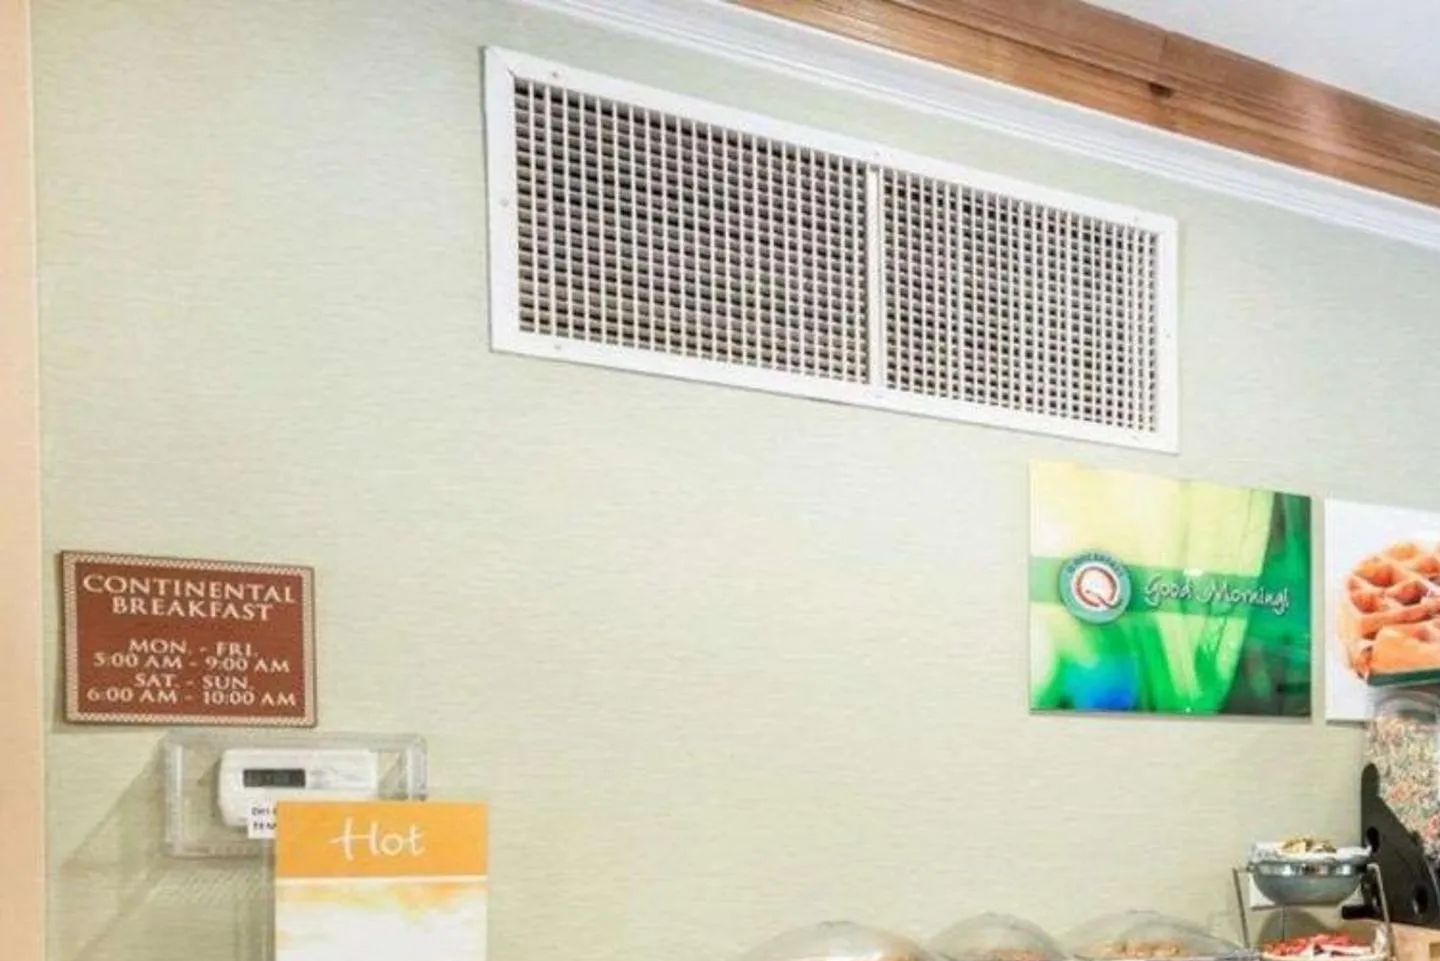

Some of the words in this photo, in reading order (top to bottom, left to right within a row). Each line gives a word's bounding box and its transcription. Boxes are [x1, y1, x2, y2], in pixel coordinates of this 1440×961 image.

[82, 573, 296, 604] CONTINENTAL
[1144, 573, 1192, 607] Good
[1196, 578, 1289, 616] Morning!
[112, 597, 274, 621] BREAKFAST
[93, 652, 138, 668] 5:00
[144, 655, 183, 669] AM
[205, 656, 248, 672] 9:00
[254, 659, 290, 673] AM
[87, 687, 133, 702] 6:00
[139, 690, 177, 704] AM
[203, 690, 255, 706] 10:00
[261, 693, 297, 708] AM
[328, 817, 426, 861] Hot
